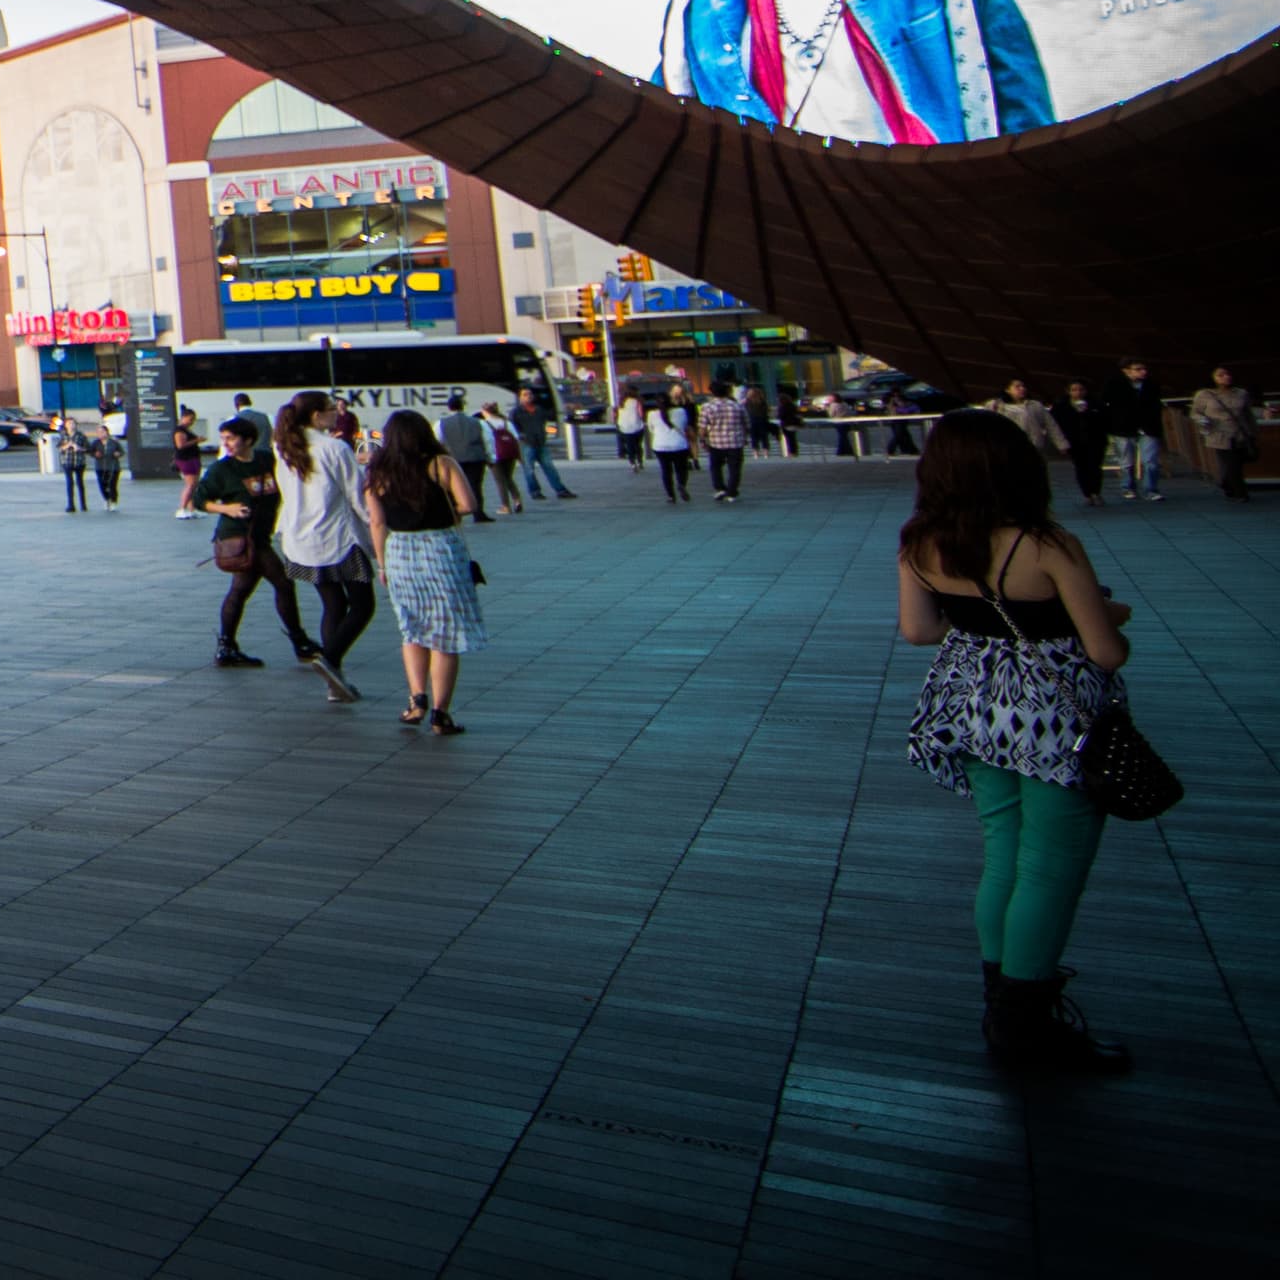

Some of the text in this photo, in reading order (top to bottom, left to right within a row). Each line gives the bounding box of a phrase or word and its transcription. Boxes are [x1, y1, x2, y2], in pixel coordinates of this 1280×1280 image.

[219, 165, 436, 201] ATLANTIC
[217, 185, 436, 216] CENTER
[229, 273, 399, 303] BEST BUY
